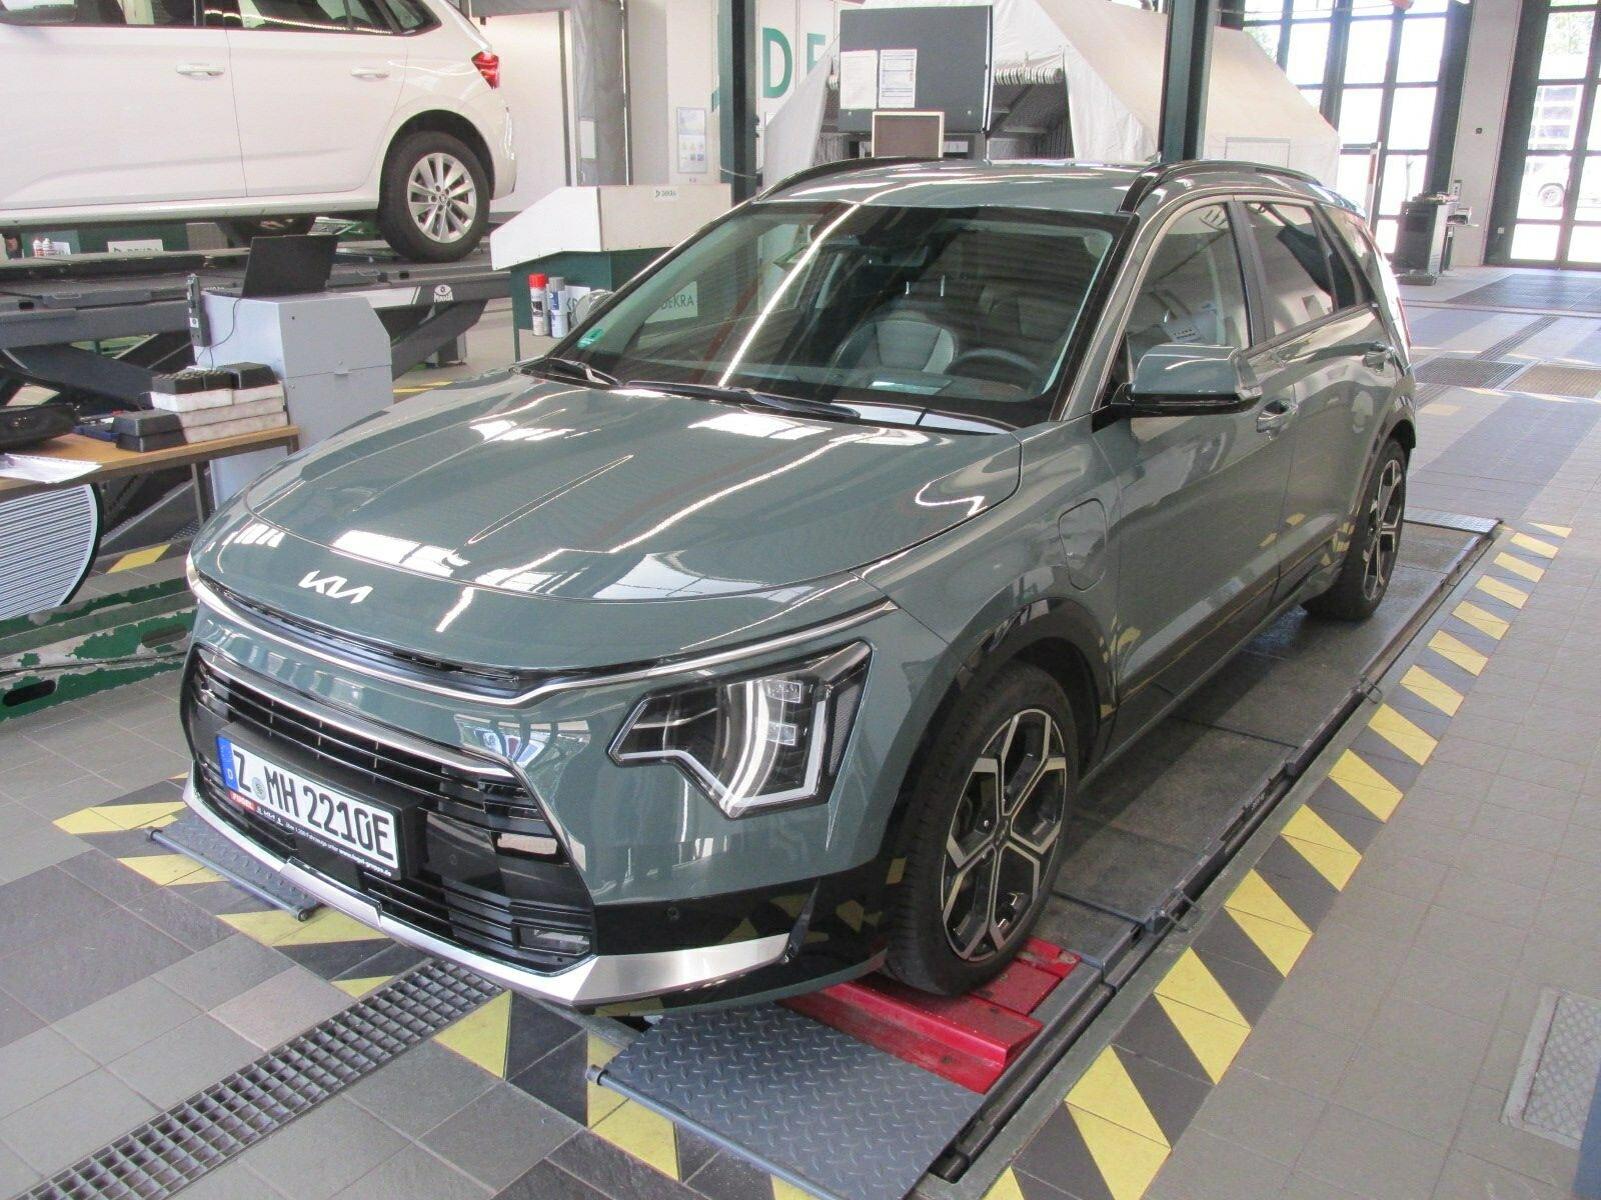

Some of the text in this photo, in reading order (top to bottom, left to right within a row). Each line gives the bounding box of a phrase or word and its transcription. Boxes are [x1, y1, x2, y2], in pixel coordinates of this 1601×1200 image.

[233, 749, 394, 861] Z MH 2210E
